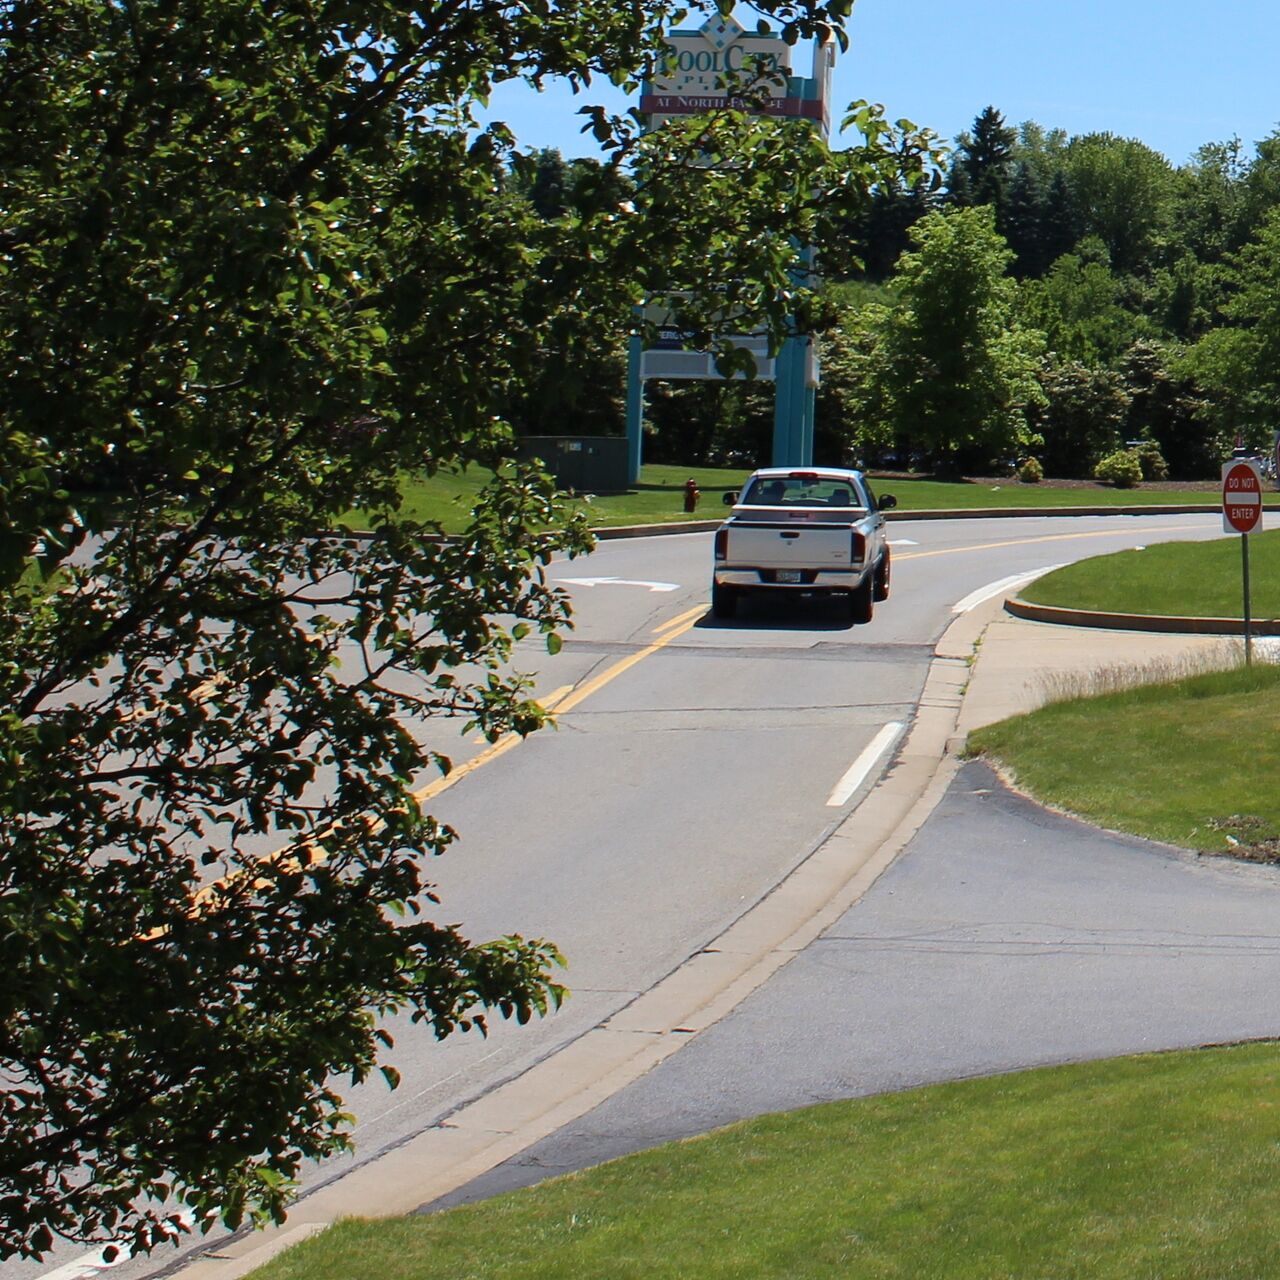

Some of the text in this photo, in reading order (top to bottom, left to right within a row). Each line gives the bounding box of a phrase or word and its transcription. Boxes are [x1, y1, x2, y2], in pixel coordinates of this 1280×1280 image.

[656, 98, 670, 107] AT
[677, 96, 724, 107] NORTH
[1229, 478, 1255, 488] DO NOT
[1232, 508, 1254, 519] ENTER
